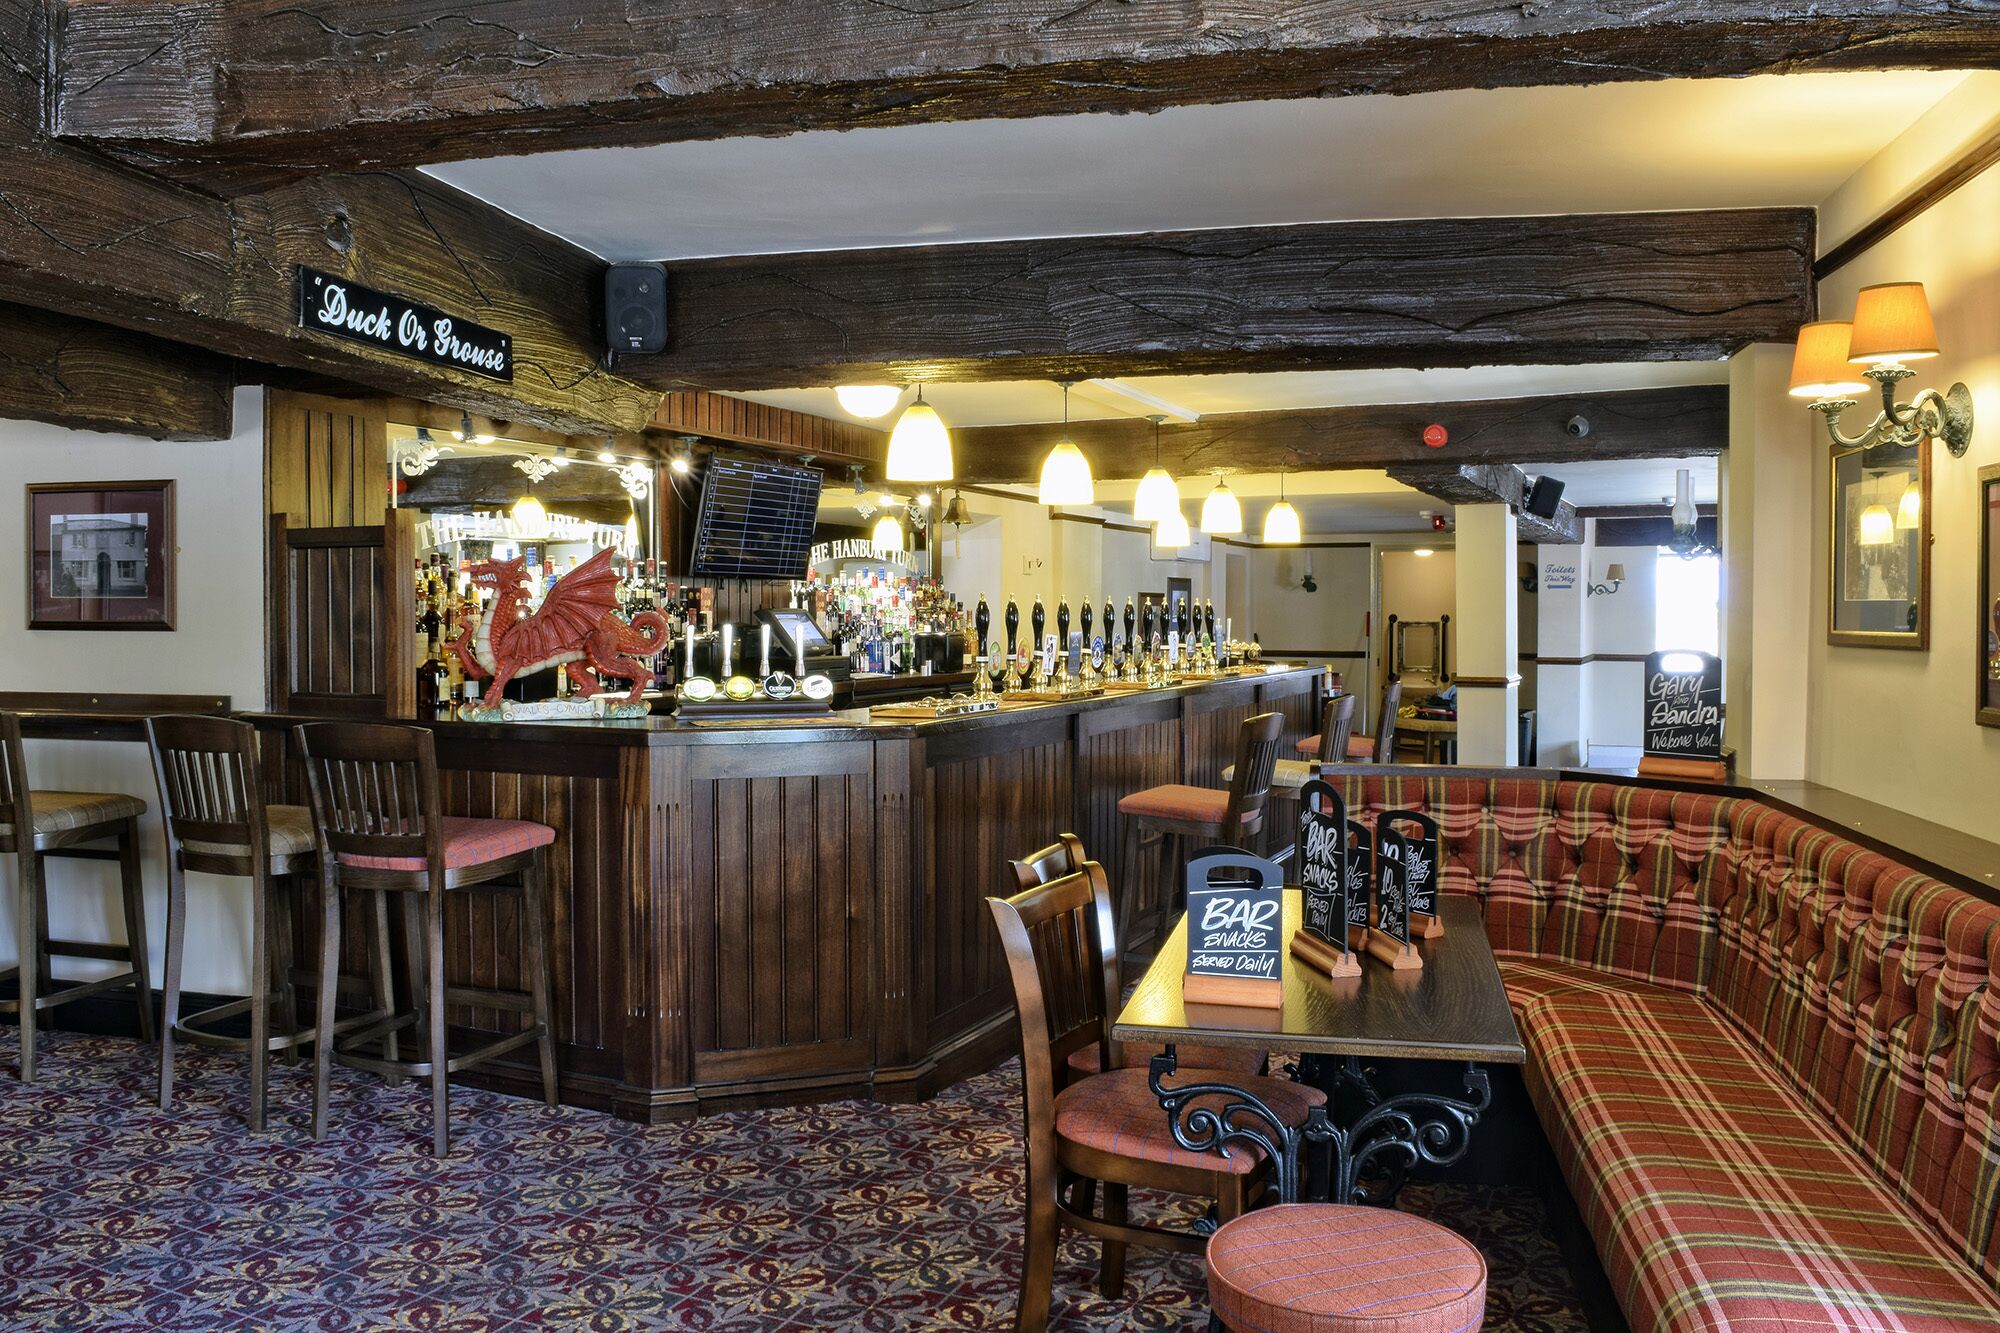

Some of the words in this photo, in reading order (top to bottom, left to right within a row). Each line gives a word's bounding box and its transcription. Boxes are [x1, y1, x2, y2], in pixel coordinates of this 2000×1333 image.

[399, 309, 427, 350] Or
[415, 514, 466, 550] THE
[810, 542, 829, 567] HE
[1545, 563, 1576, 573] Toilets
[1560, 575, 1576, 584] Way
[1650, 672, 1704, 703] Gary
[1651, 700, 1719, 727] Sandra
[1652, 729, 1693, 749] Welcome
[1306, 820, 1338, 870] BAR
[1303, 863, 1339, 893] SNACKS
[1381, 865, 1393, 895] 10
[1201, 897, 1279, 932] BAR
[1308, 894, 1329, 913] SERVED
[1380, 904, 1388, 929] 2
[1203, 931, 1267, 949] SNACKS
[1192, 954, 1235, 969] SERVED
[1235, 953, 1275, 977] Daily
